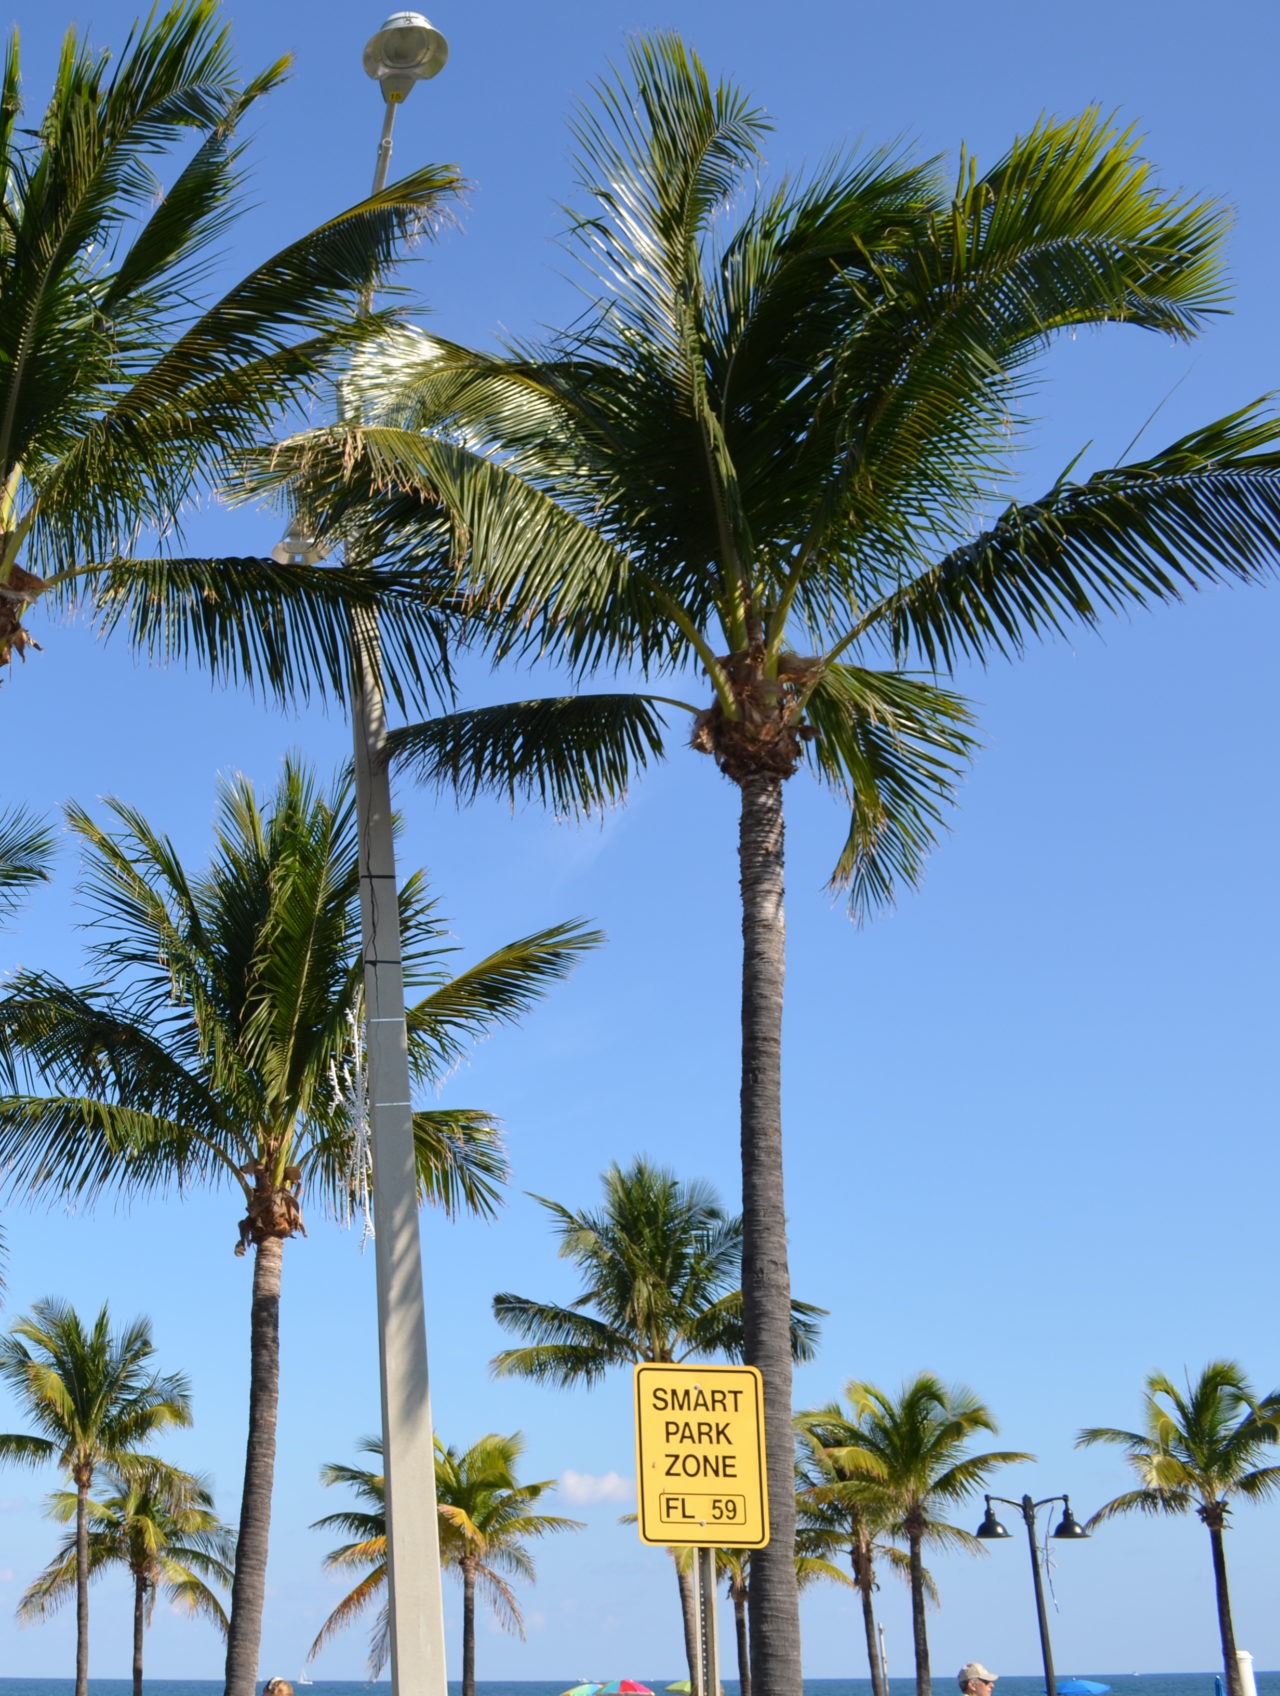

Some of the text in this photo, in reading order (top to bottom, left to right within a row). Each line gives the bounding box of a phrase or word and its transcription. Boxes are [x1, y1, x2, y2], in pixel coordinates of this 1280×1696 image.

[652, 1387, 743, 1412] SMART
[665, 1421, 733, 1445] PARK
[664, 1454, 737, 1478] ZONE
[666, 1497, 737, 1520] FL 59
